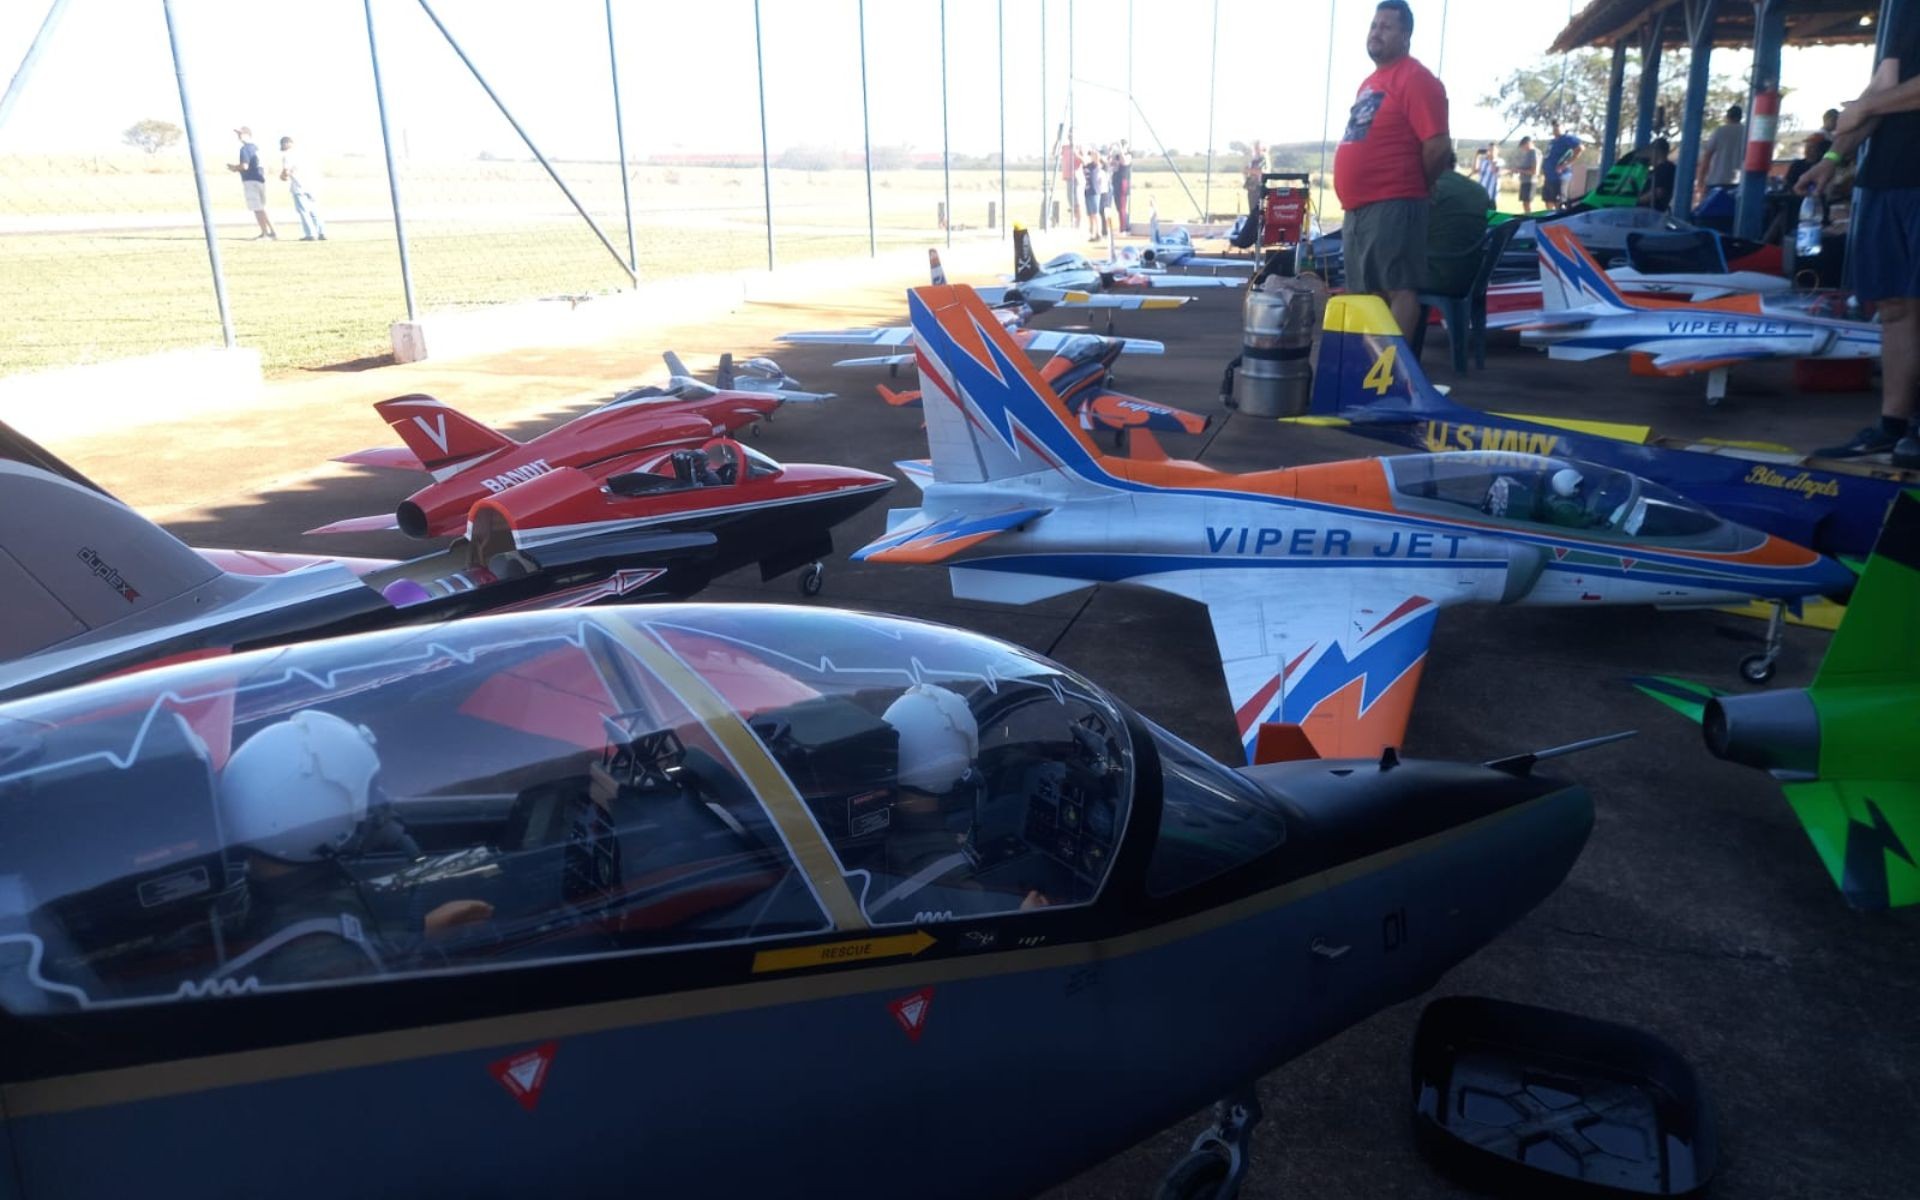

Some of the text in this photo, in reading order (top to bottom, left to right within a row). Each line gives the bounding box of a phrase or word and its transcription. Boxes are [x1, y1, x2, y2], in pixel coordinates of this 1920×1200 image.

[1667, 320, 1739, 334] VIPER
[1362, 345, 1397, 395] 4
[412, 413, 449, 456] V
[480, 459, 552, 493] BANDIT
[1206, 527, 1468, 559] VIPER JET
[77, 546, 141, 604] duplex
[821, 943, 872, 959] RESCUE
